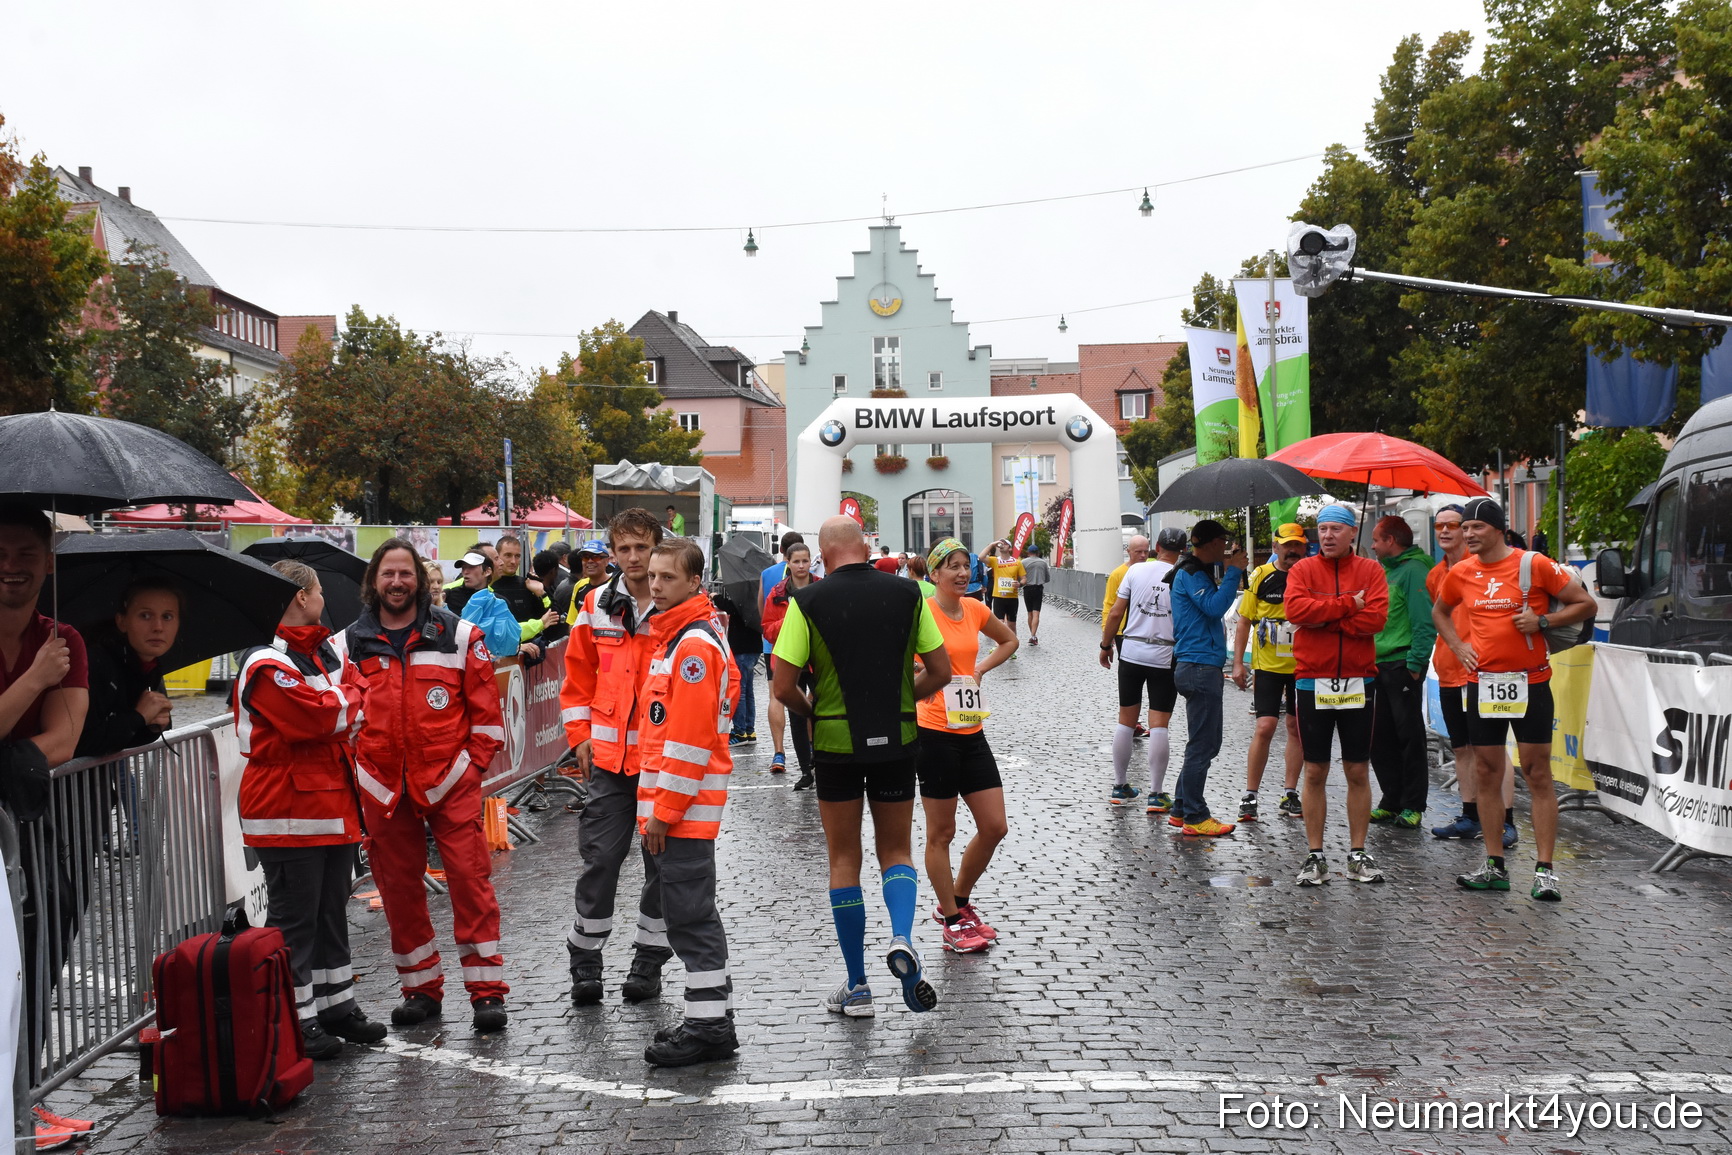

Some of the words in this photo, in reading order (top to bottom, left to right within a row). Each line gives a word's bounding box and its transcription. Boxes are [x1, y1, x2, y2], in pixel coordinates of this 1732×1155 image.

[1208, 366, 1236, 376] Neumark
[1202, 372, 1237, 386] Lammsb
[855, 408, 925, 429] BMW
[932, 406, 1056, 431] Laufsport
[1058, 505, 1072, 548] REWE
[1013, 516, 1032, 551] REWE
[1474, 597, 1511, 608] funrunners
[1485, 602, 1519, 611] neumarkt
[1330, 678, 1350, 693] 87
[1487, 683, 1519, 701] 158
[954, 688, 981, 709] 131
[1319, 696, 1362, 704] Hans-Werner
[1492, 704, 1511, 712] Peter
[958, 713, 982, 722] Claudia
[885, 872, 905, 882] ALKE
